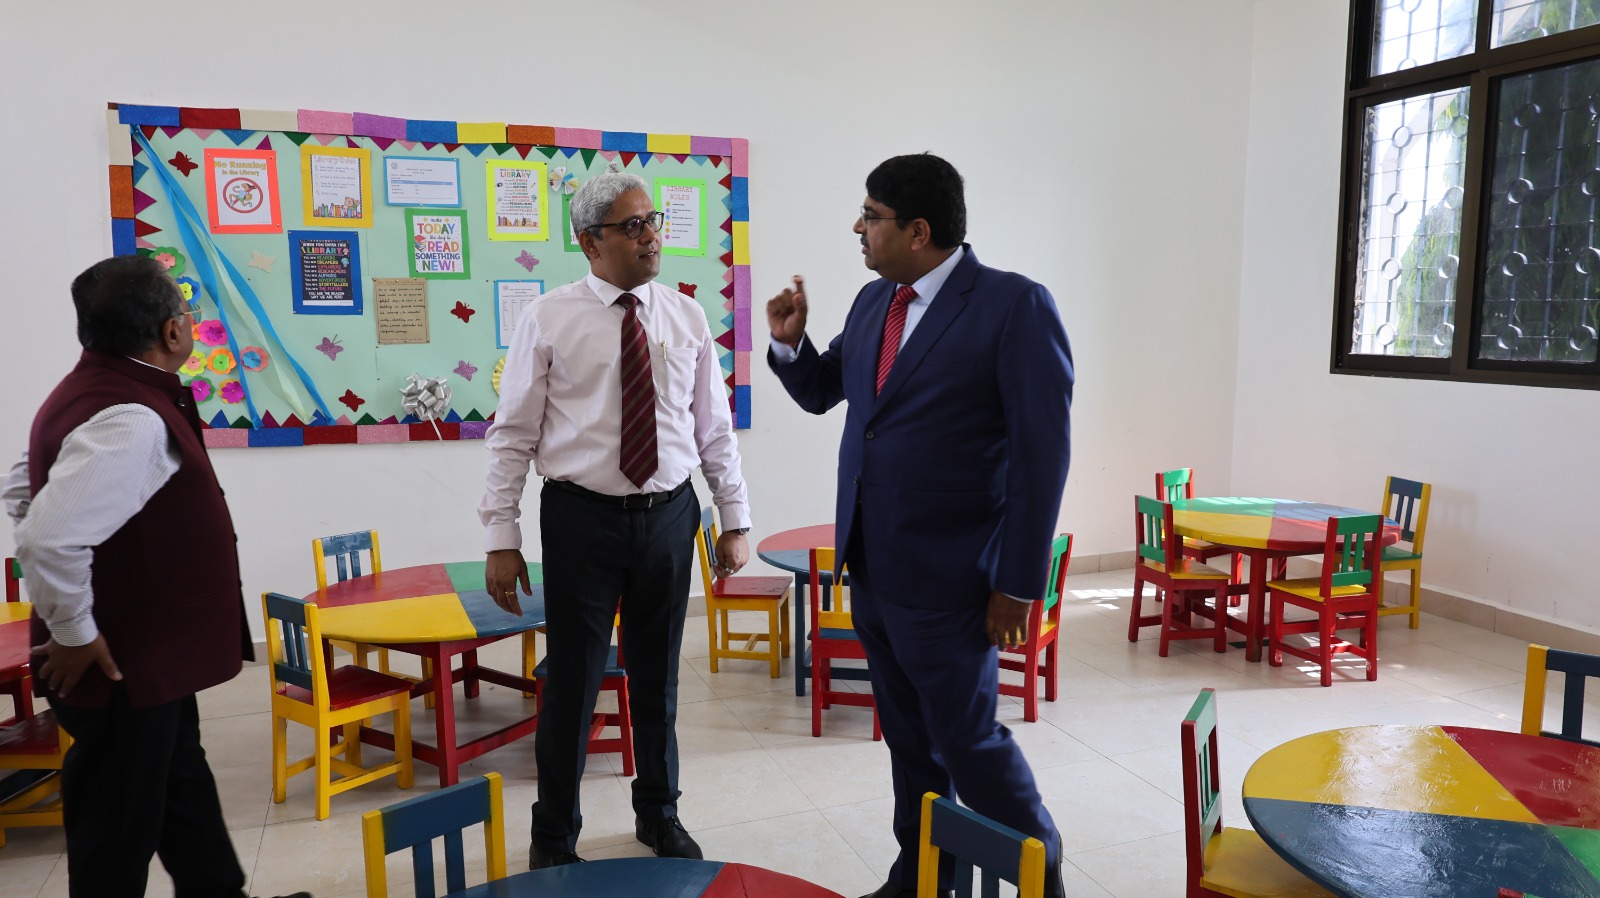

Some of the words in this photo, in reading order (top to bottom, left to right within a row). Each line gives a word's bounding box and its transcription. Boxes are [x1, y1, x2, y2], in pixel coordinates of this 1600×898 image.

[314, 156, 338, 164] Library
[230, 161, 266, 170] Running
[417, 223, 455, 234] TODAY
[427, 241, 459, 252] READ
[415, 252, 461, 260] SOMETHING
[422, 260, 455, 272] NEW!
